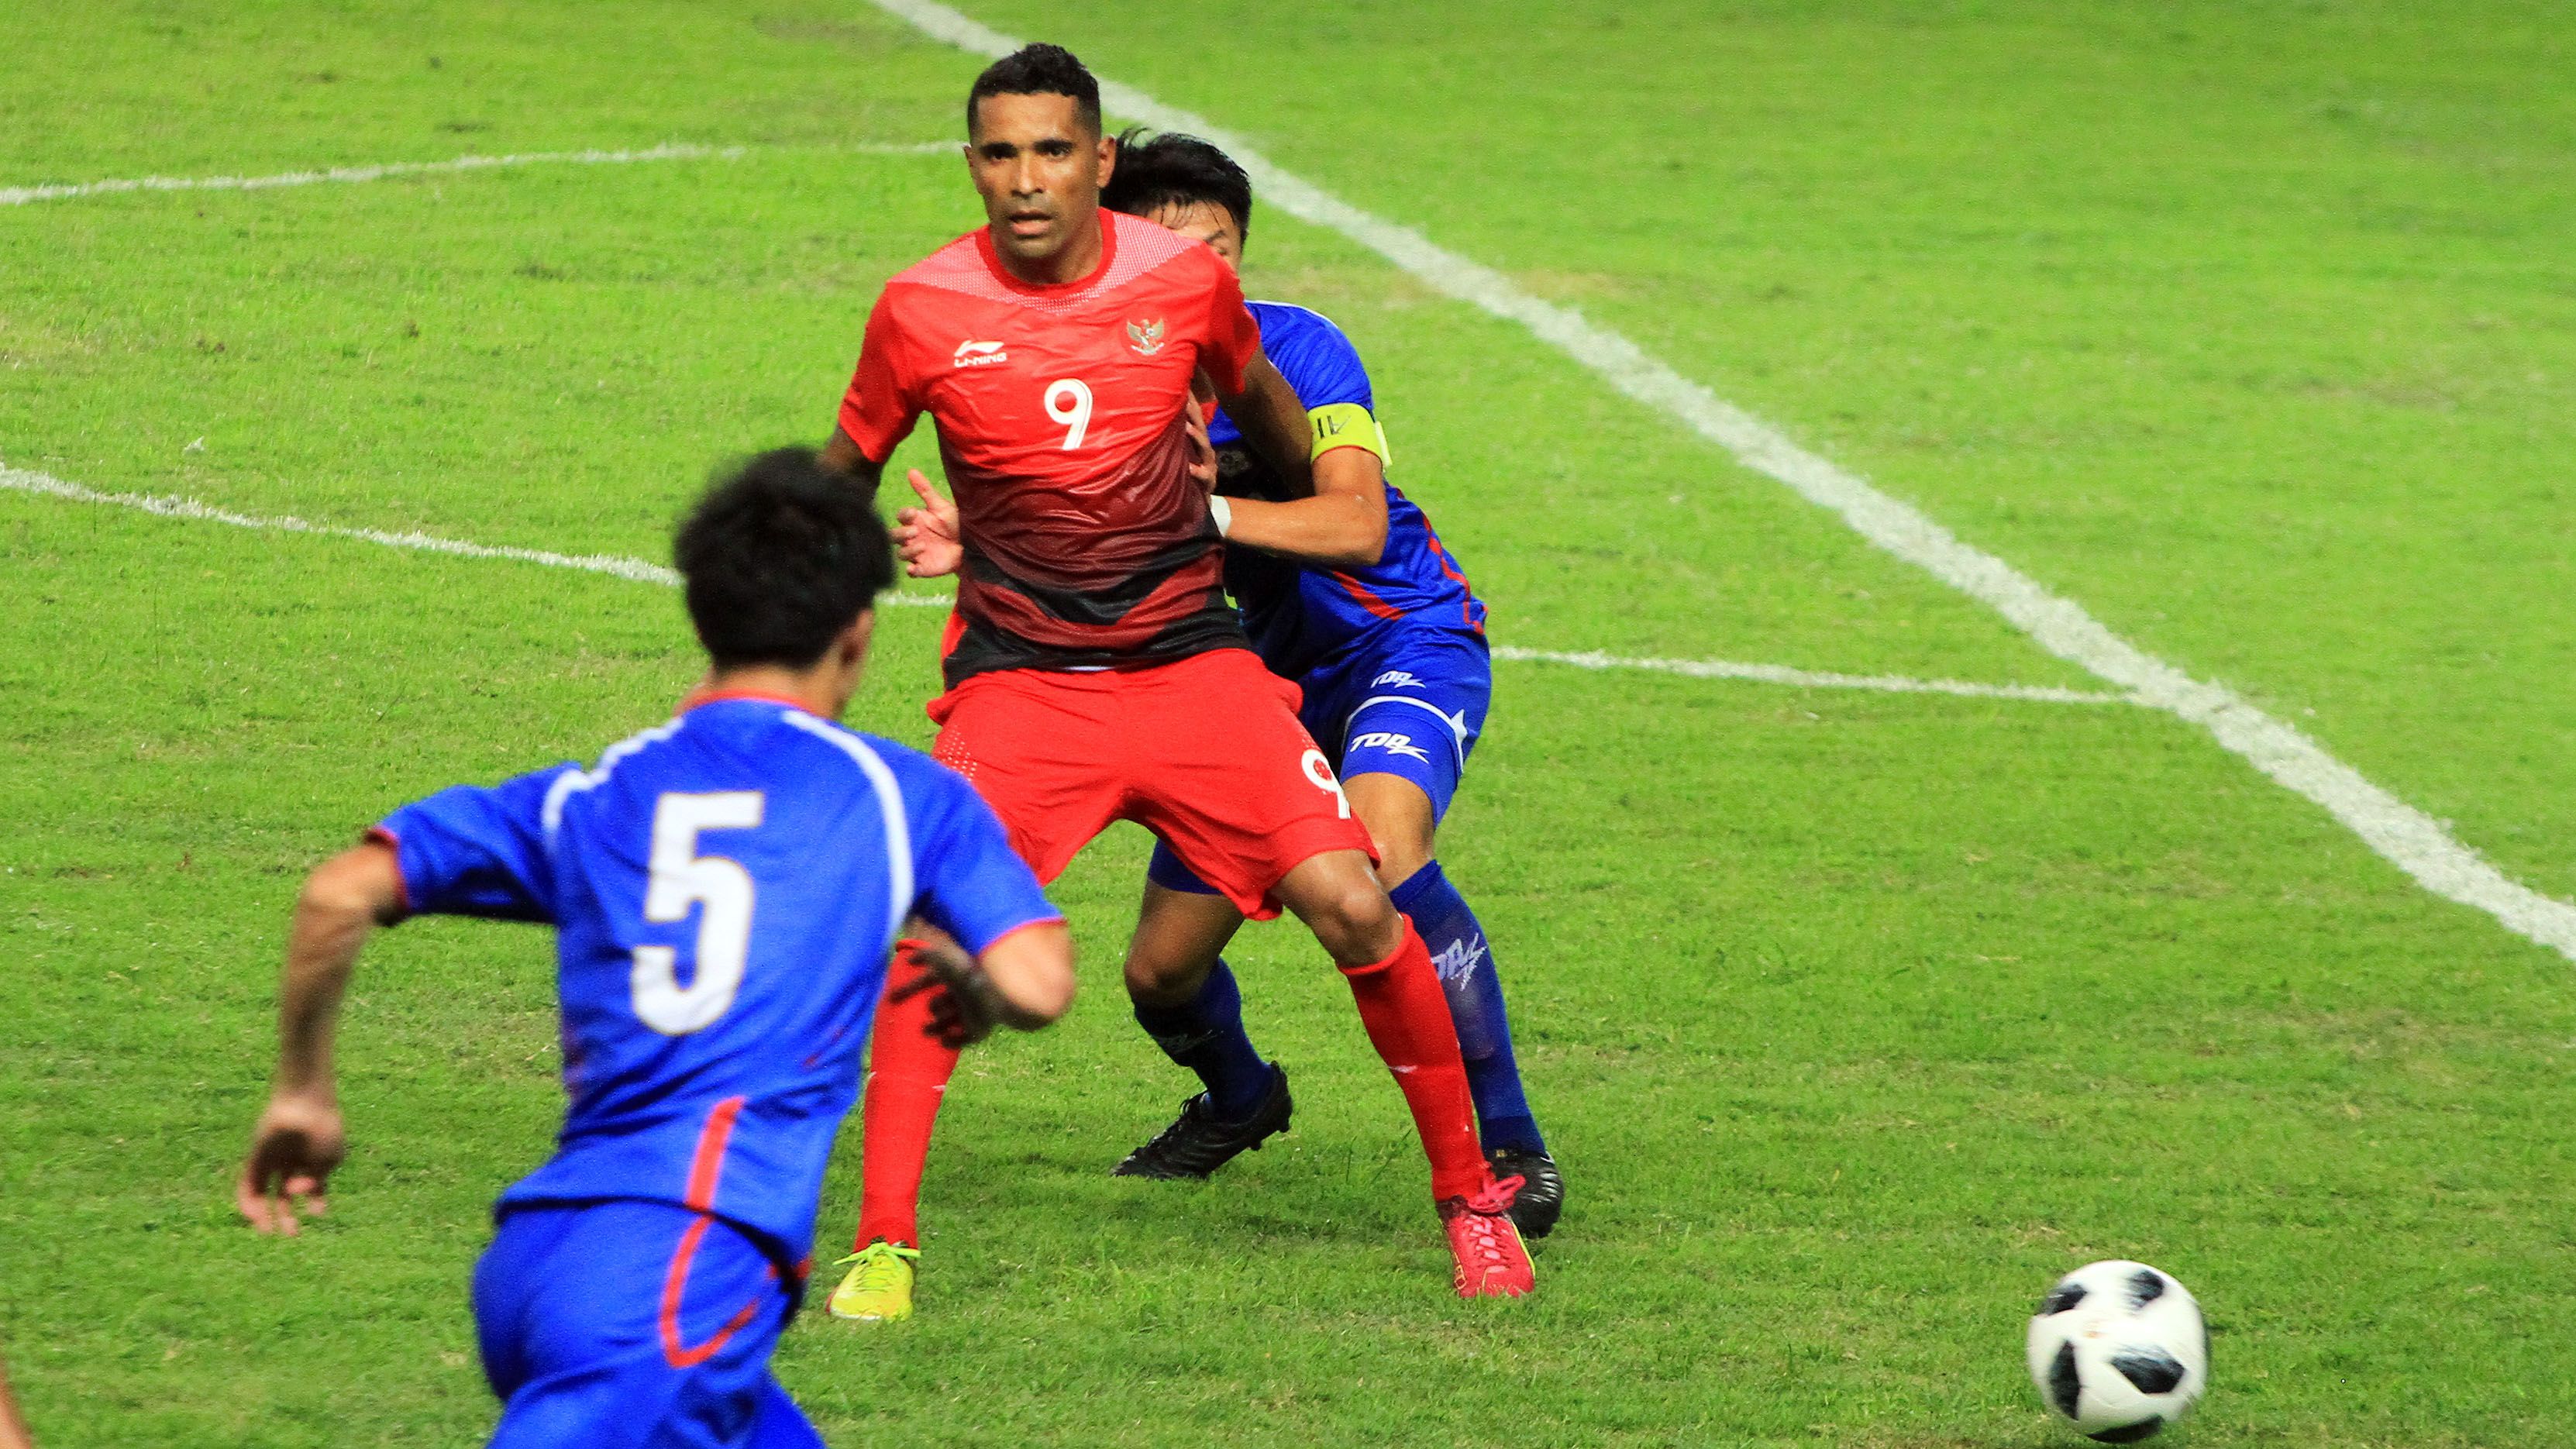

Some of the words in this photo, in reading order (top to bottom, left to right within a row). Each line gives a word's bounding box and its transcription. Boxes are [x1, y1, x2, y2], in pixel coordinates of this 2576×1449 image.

[1044, 377, 1093, 450] 9
[1300, 749, 1351, 820] 9
[630, 790, 766, 1037] 5
